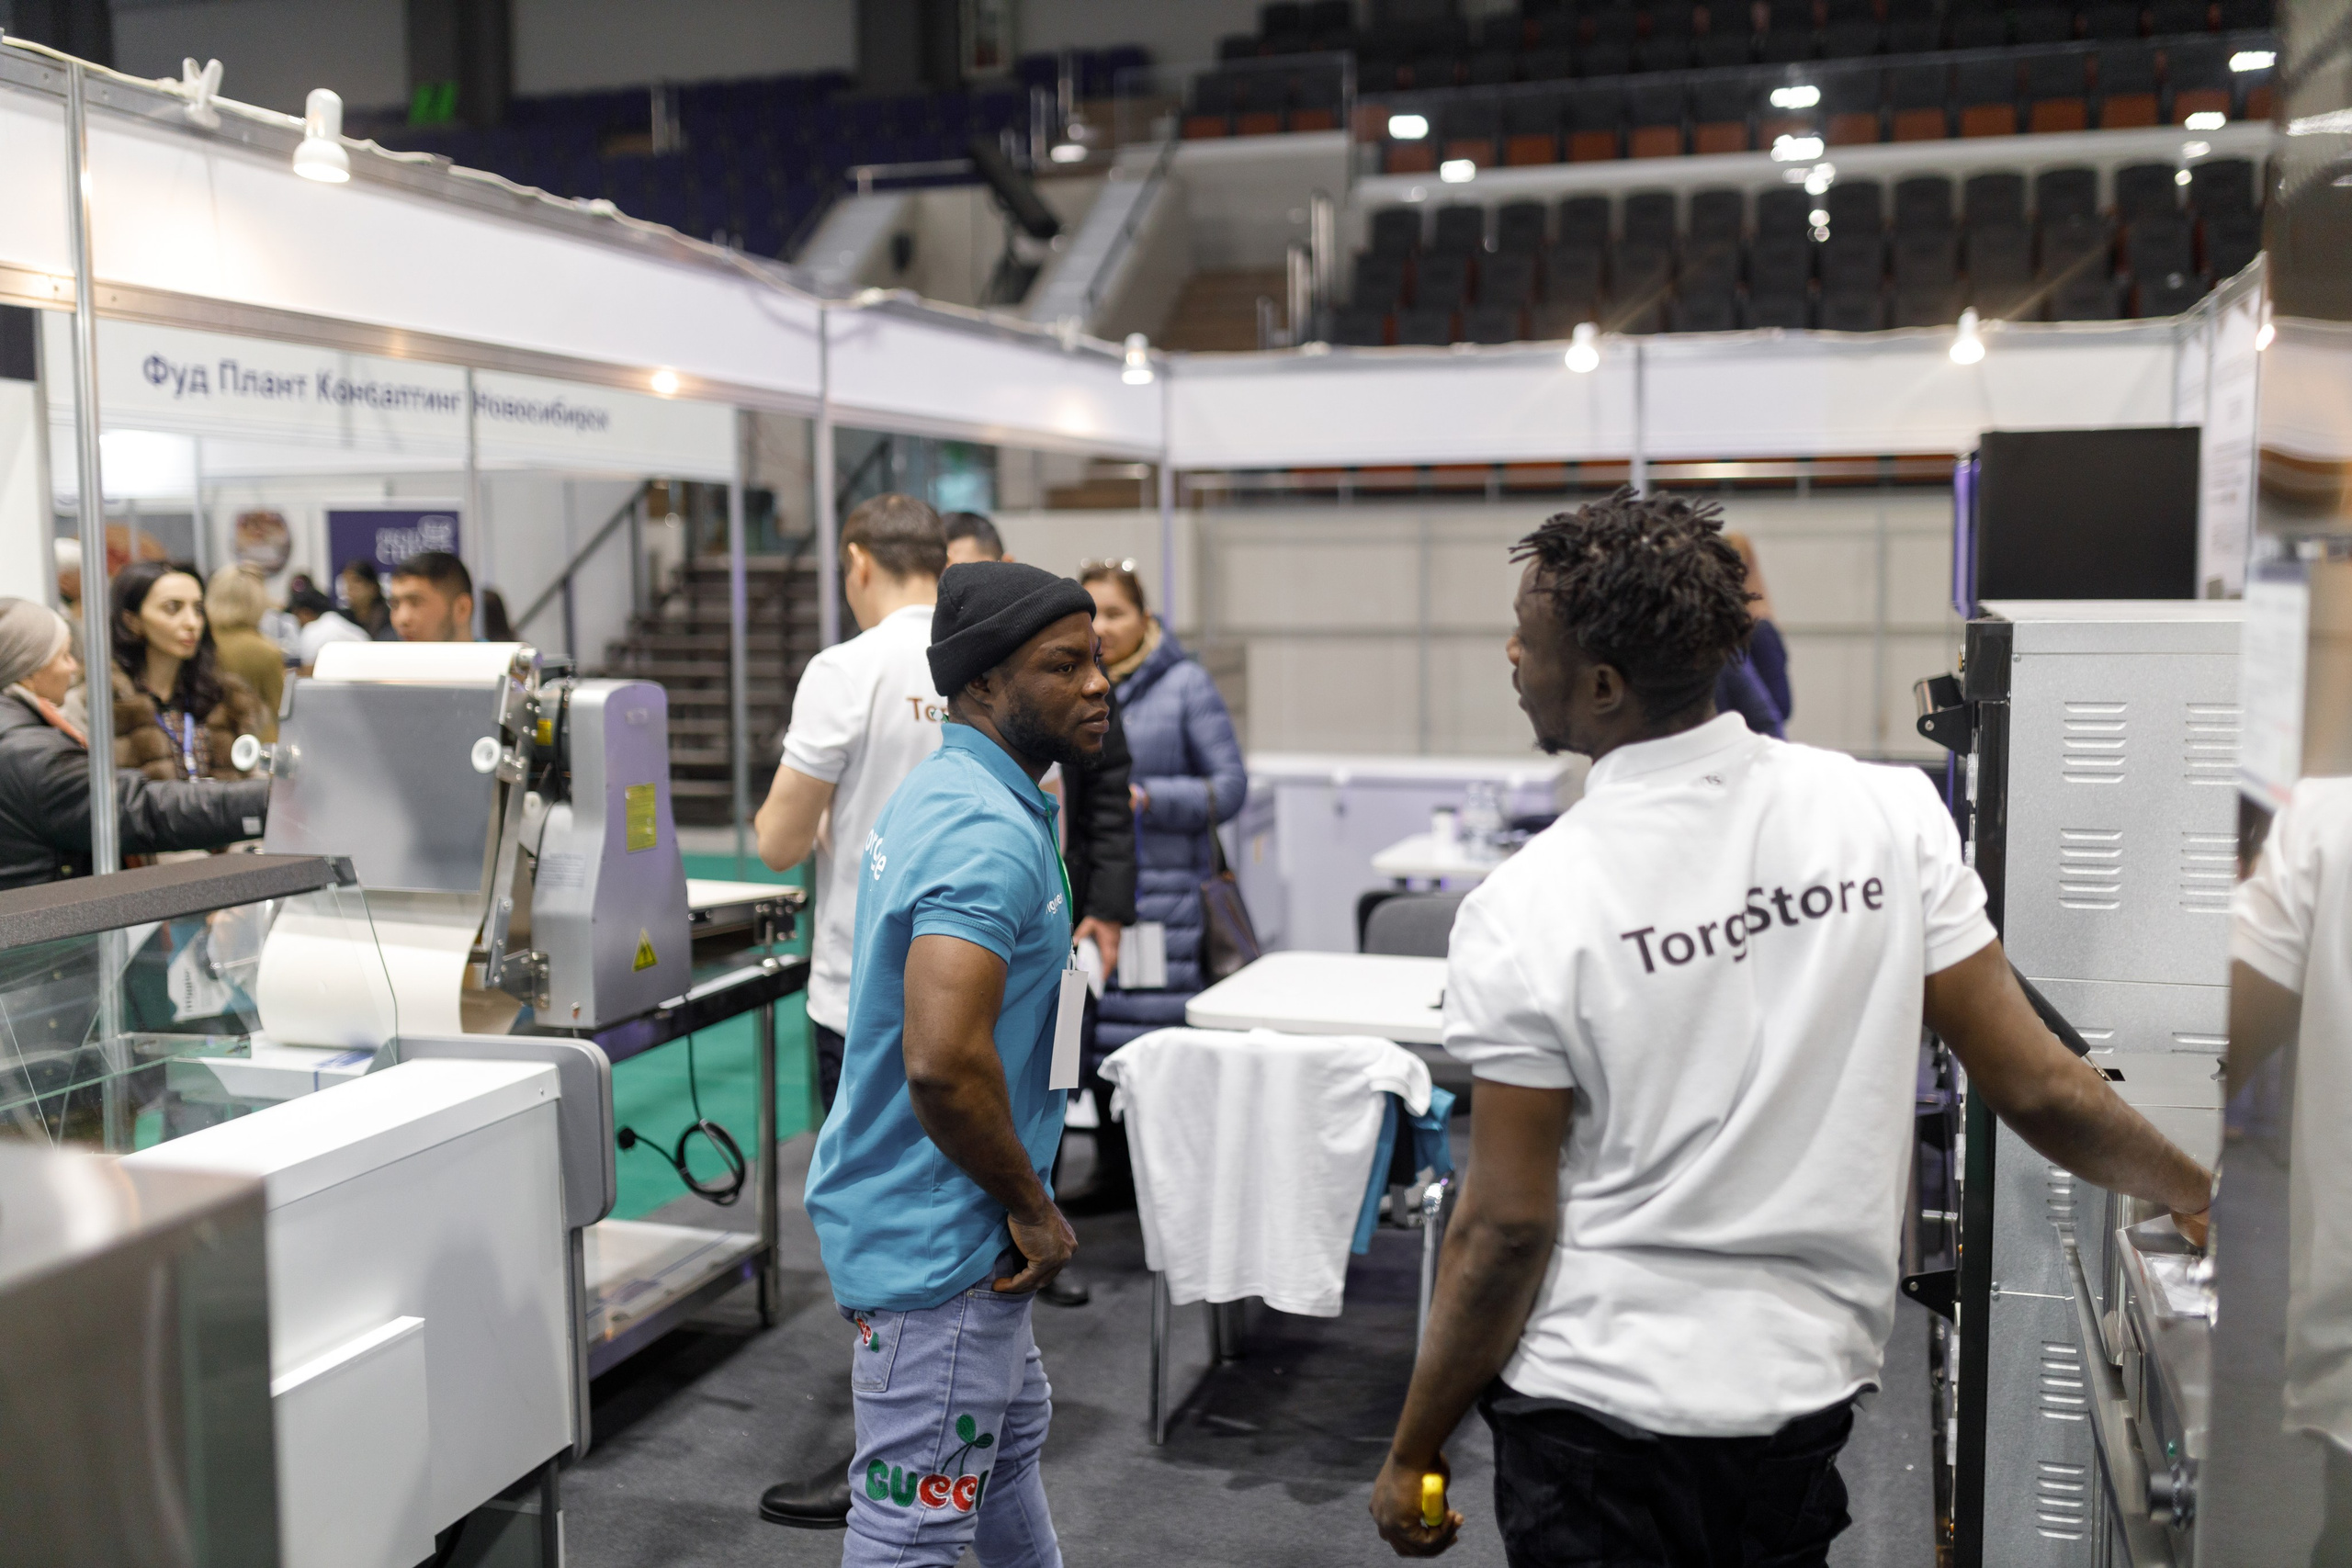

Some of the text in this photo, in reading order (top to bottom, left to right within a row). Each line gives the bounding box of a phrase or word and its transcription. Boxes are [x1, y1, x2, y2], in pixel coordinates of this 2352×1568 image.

[142, 353, 210, 400] Фуд
[218, 358, 308, 402] Плант
[315, 369, 465, 418] Консалтинг
[1621, 875, 1884, 976] TorgStore
